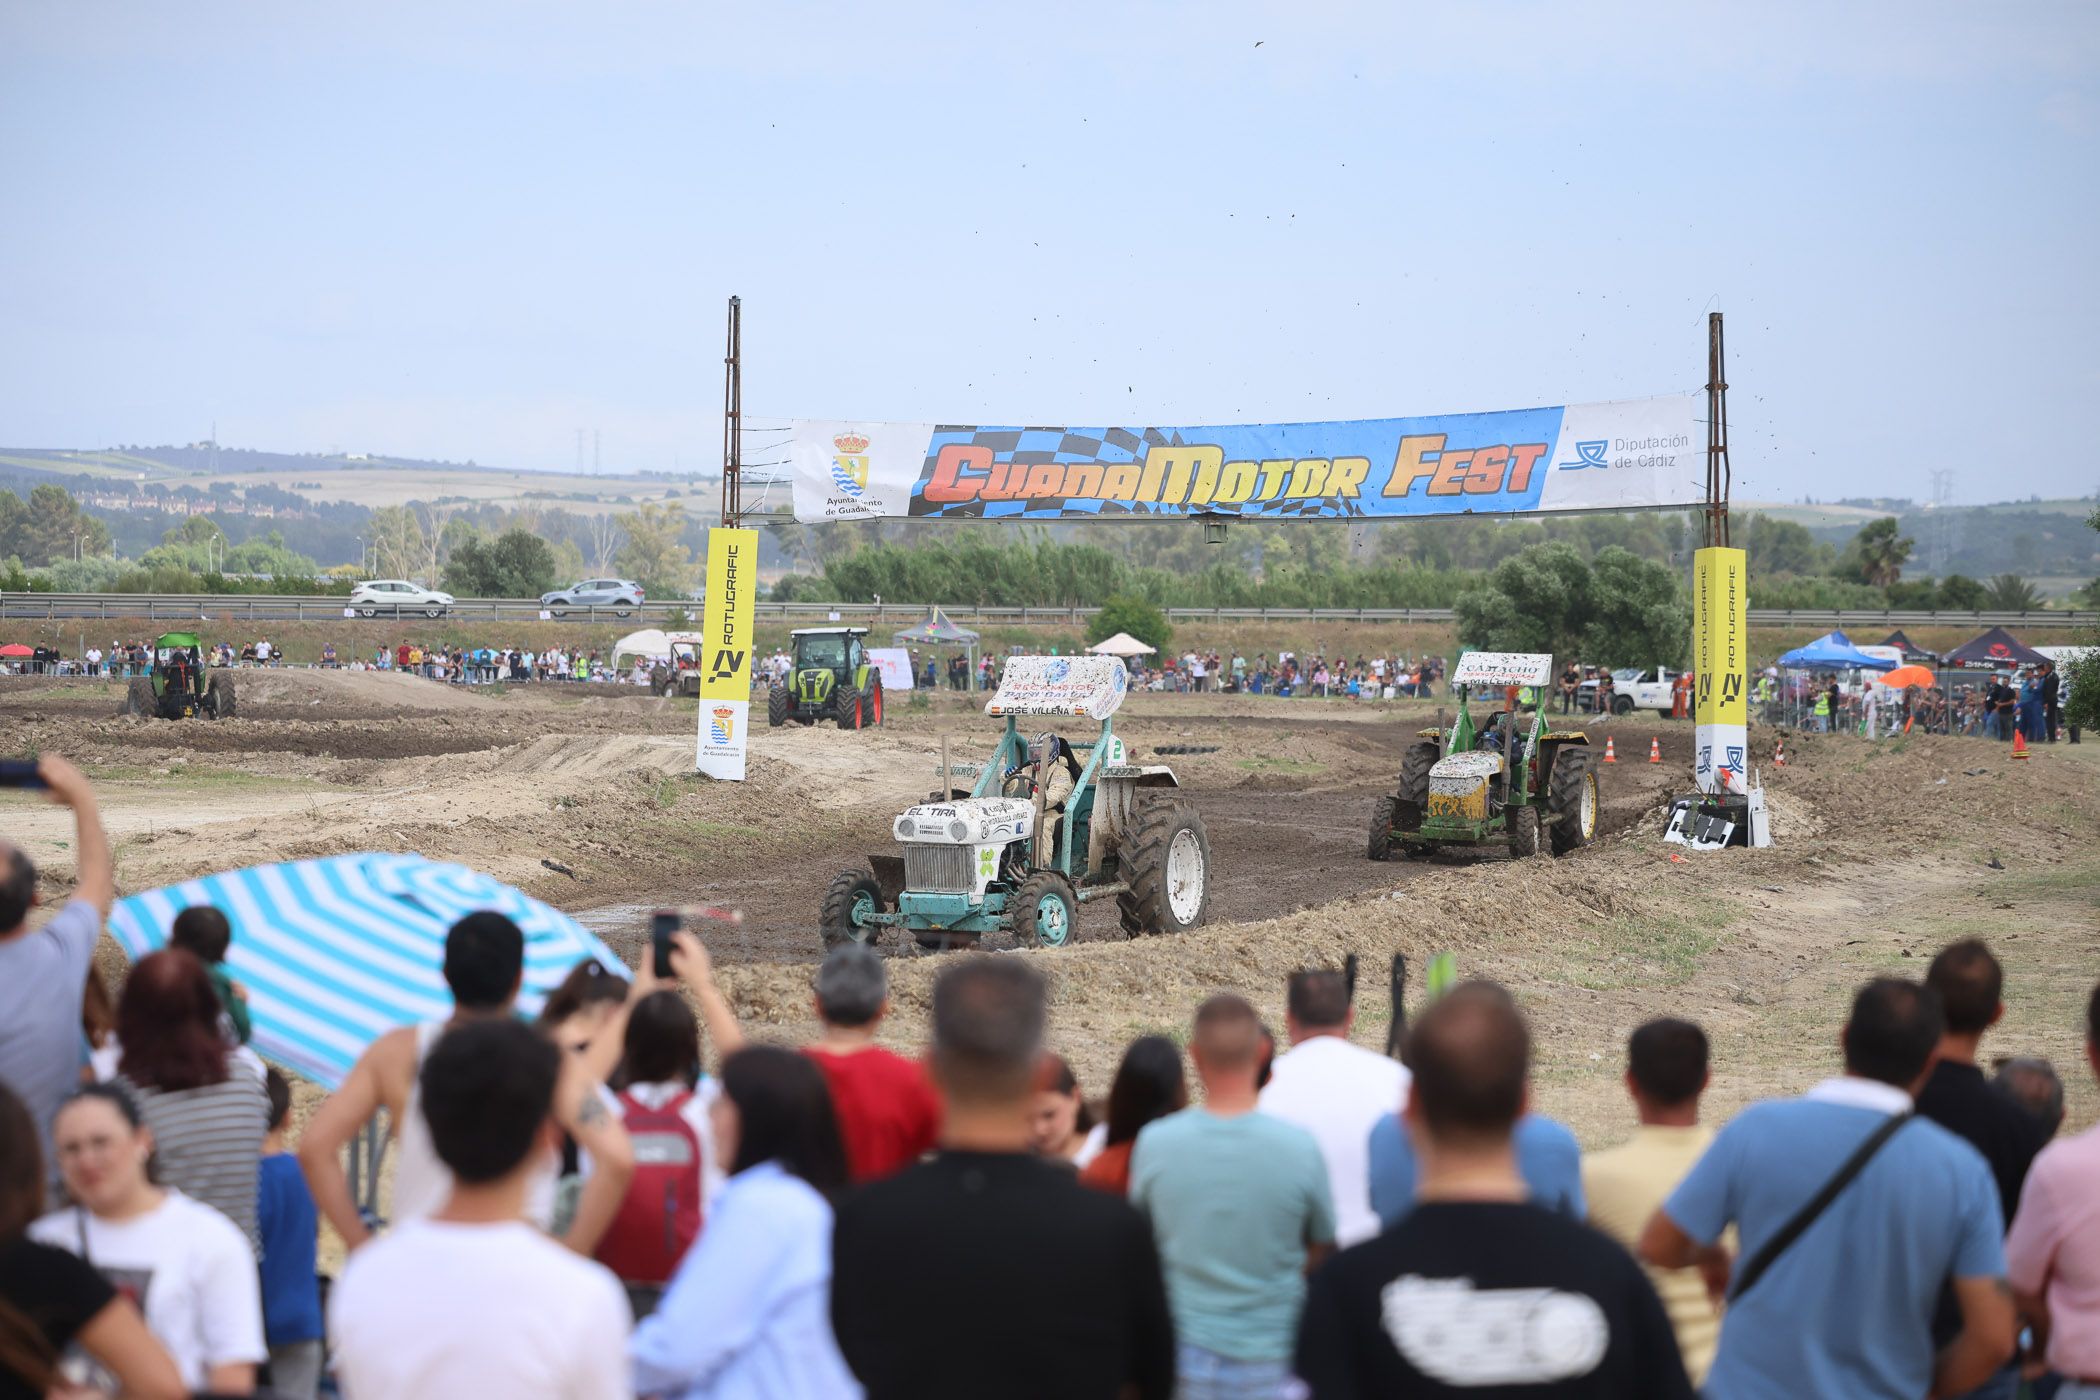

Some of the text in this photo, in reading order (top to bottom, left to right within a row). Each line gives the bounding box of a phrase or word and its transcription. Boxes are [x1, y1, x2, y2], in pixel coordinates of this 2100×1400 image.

[1615, 433, 1688, 452] Diputación
[1614, 453, 1676, 468] de Cádiz
[825, 508, 836, 516] de
[723, 545, 738, 645] ROTUGRAFIC
[1001, 706, 1028, 714] JOSE
[1113, 740, 1122, 760] 2
[908, 807, 956, 817] EL TIRA
